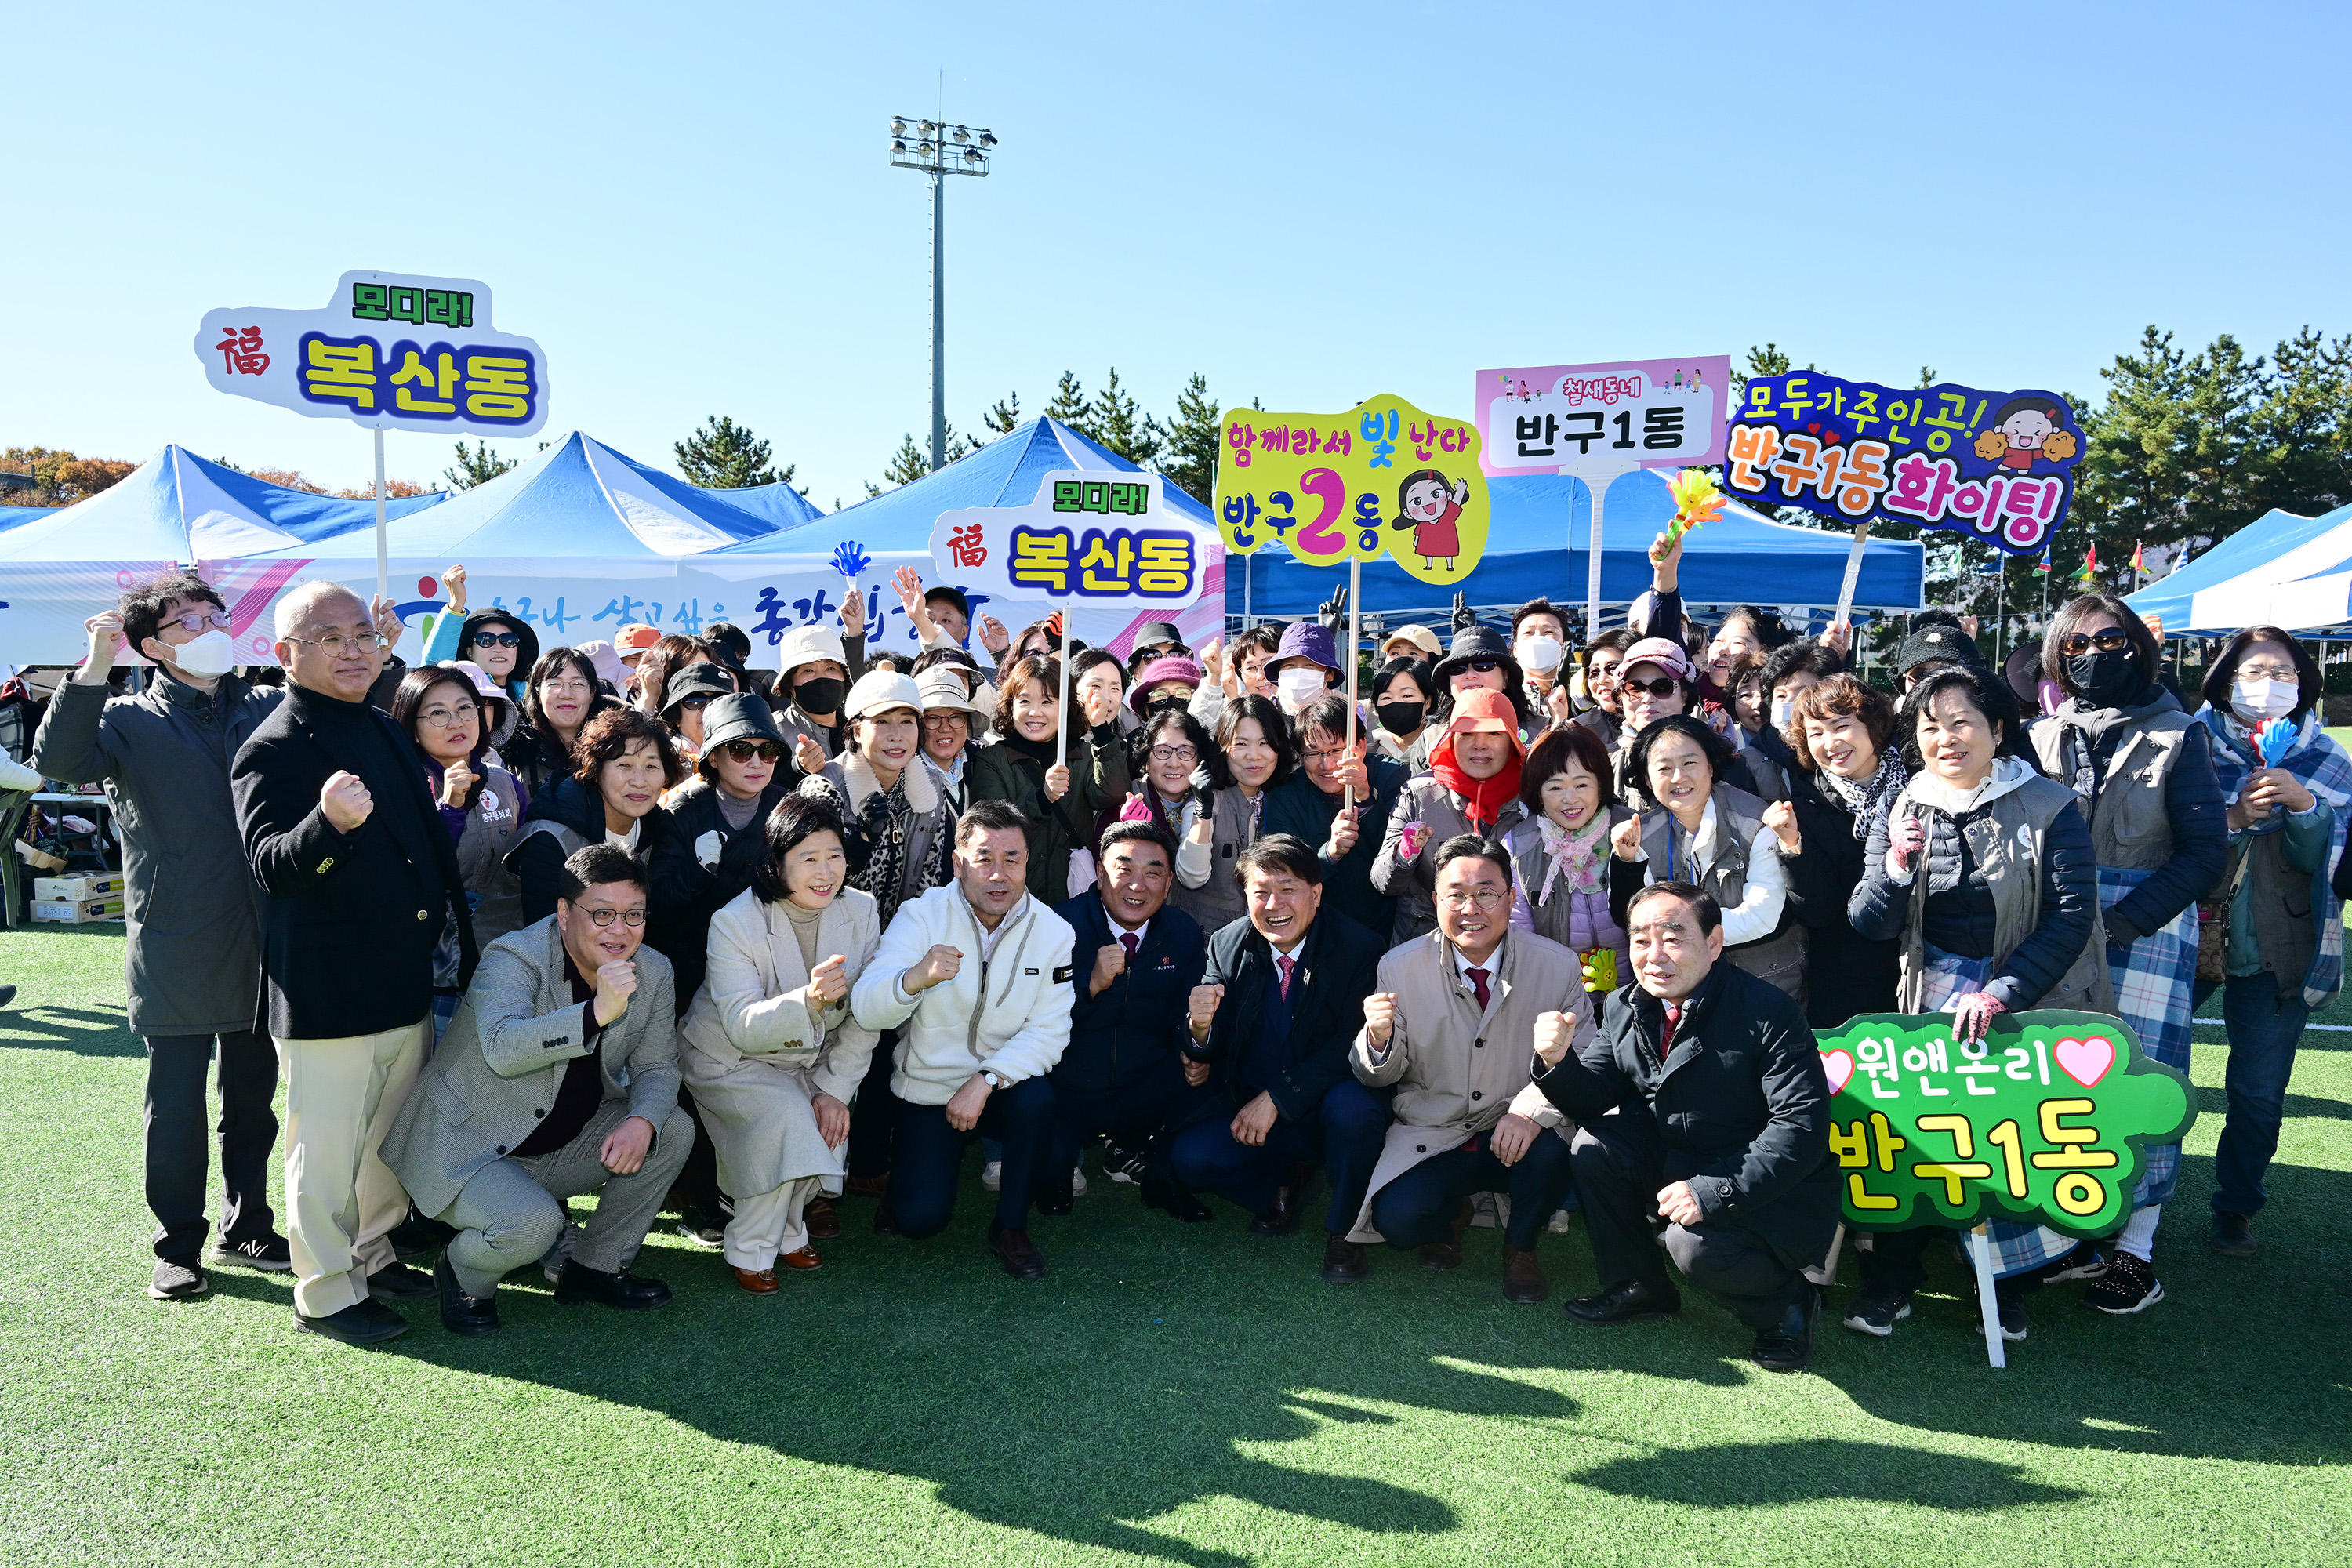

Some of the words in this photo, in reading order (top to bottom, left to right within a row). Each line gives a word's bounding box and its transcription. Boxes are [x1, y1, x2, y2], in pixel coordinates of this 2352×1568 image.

[352, 282, 474, 328] 모디라!
[216, 325, 270, 376] 福
[305, 339, 530, 418] 복산동
[1563, 376, 1642, 406] 철새동네
[1227, 422, 1352, 468] 함께라서
[1515, 406, 1685, 457] 반구1동
[1053, 481, 1149, 515] 모디라!
[1730, 427, 1889, 514] 반구1동
[1886, 457, 2059, 543] 화이팅
[946, 524, 988, 568] 福
[1014, 532, 1191, 591] 복산동
[492, 596, 581, 634] 구나
[1857, 1036, 2051, 1098] 원앤온리
[1829, 1097, 2119, 1217] 반구1동
